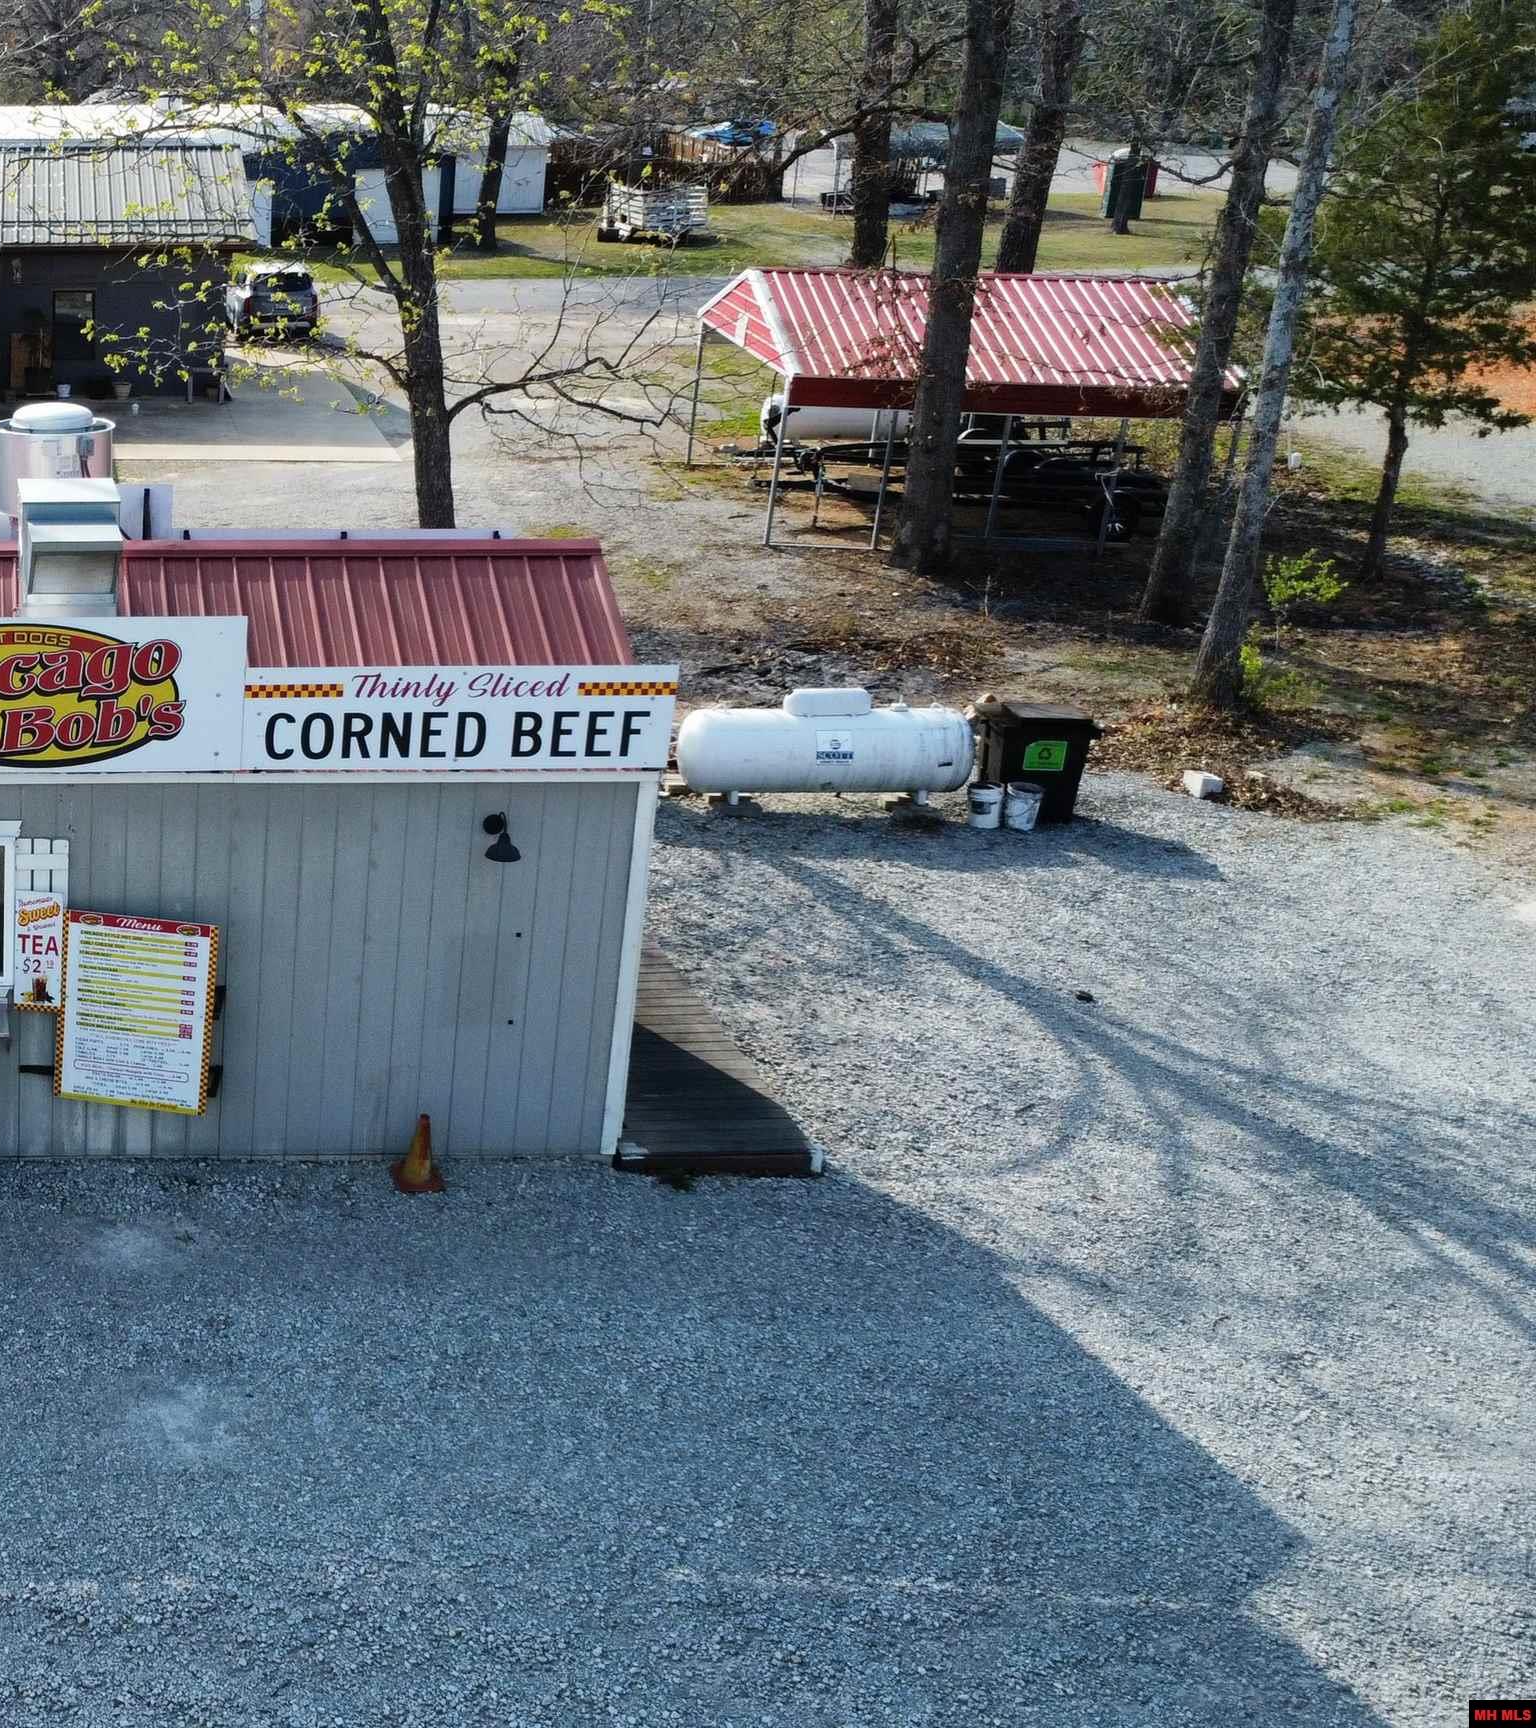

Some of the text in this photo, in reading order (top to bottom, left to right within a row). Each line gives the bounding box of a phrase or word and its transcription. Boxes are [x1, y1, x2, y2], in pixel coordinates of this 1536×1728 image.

[13, 631, 72, 648] DOGS
[352, 673, 571, 707] Thinly Sliced
[0, 694, 186, 756] Bob's
[264, 710, 651, 760] CORNED BEEF
[18, 901, 60, 926] Sweet
[116, 917, 163, 931] Menu
[17, 934, 59, 956] TEA
